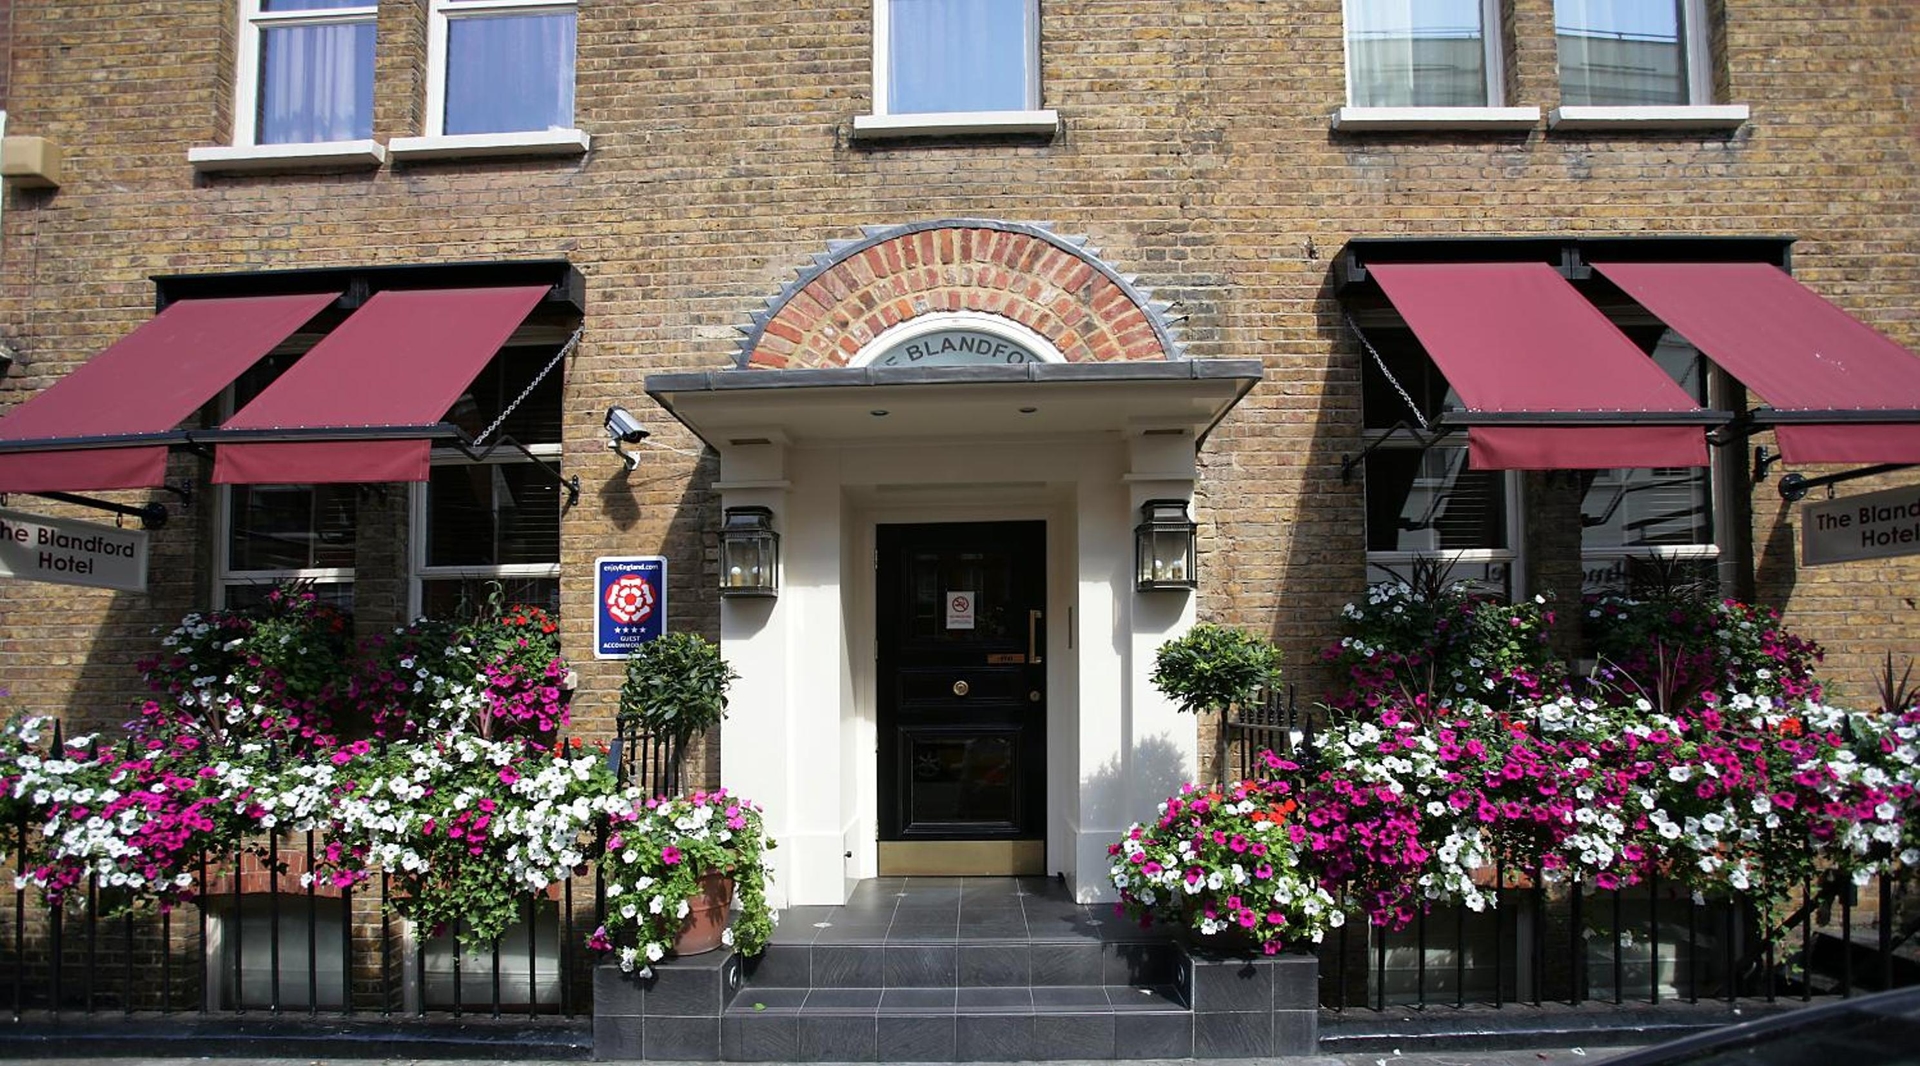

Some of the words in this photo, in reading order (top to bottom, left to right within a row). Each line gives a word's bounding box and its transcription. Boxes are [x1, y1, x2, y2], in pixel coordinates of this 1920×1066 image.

[905, 336, 1032, 365] BLANDFO
[1816, 513, 1852, 531] The
[1859, 498, 1920, 524] Bland
[0, 521, 29, 542] he
[38, 528, 135, 558] Blandford
[1862, 523, 1920, 548] Hotel
[39, 551, 94, 574] Hotel
[603, 564, 659, 572] enjoyEngland.com
